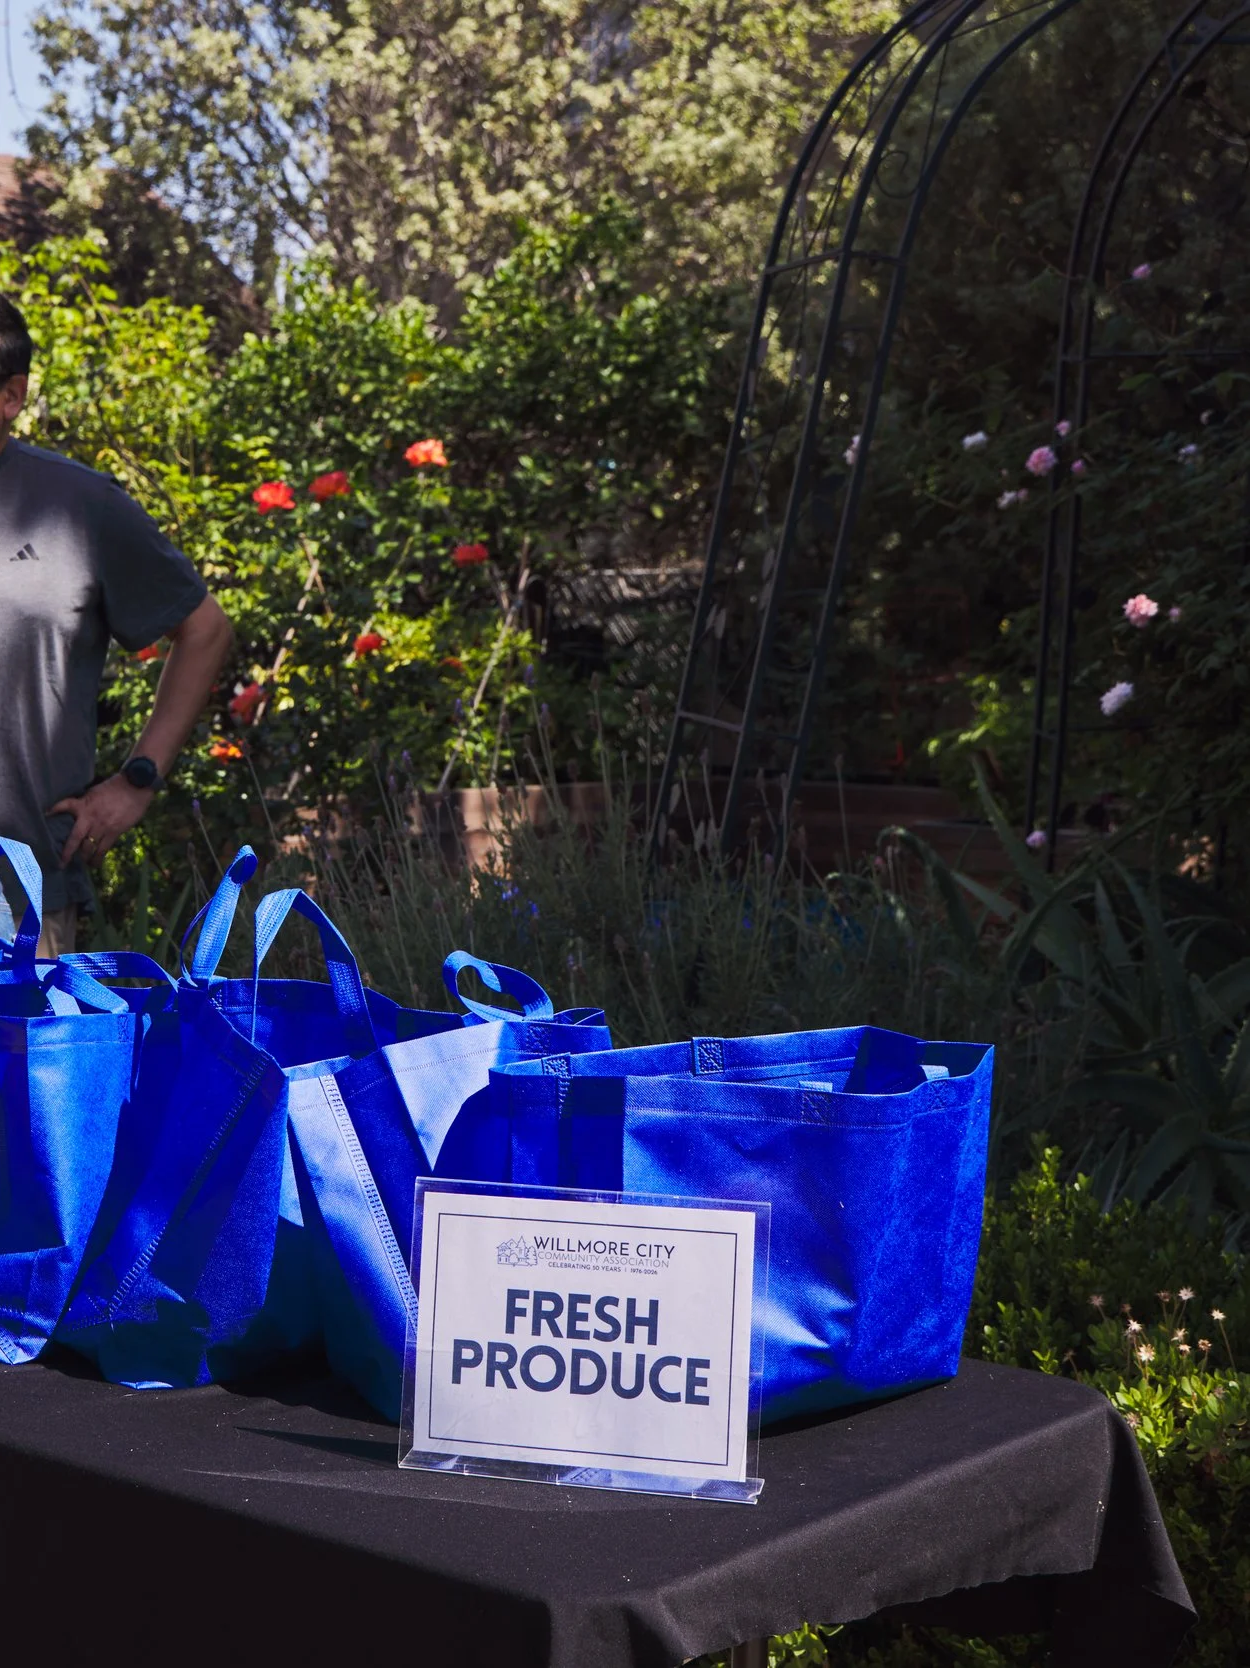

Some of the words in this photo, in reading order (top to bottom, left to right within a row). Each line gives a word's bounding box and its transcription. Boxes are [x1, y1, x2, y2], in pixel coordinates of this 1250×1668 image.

[533, 1235, 630, 1257] WILLMORE
[636, 1243, 675, 1259] CITY
[537, 1251, 600, 1264] COMMUNITY
[602, 1256, 670, 1269] ASSOCIATION
[547, 1261, 591, 1271] CELEBRATING
[601, 1265, 622, 1273] YEARS
[504, 1288, 660, 1346] FRESH
[451, 1338, 711, 1406] PRODUCE
